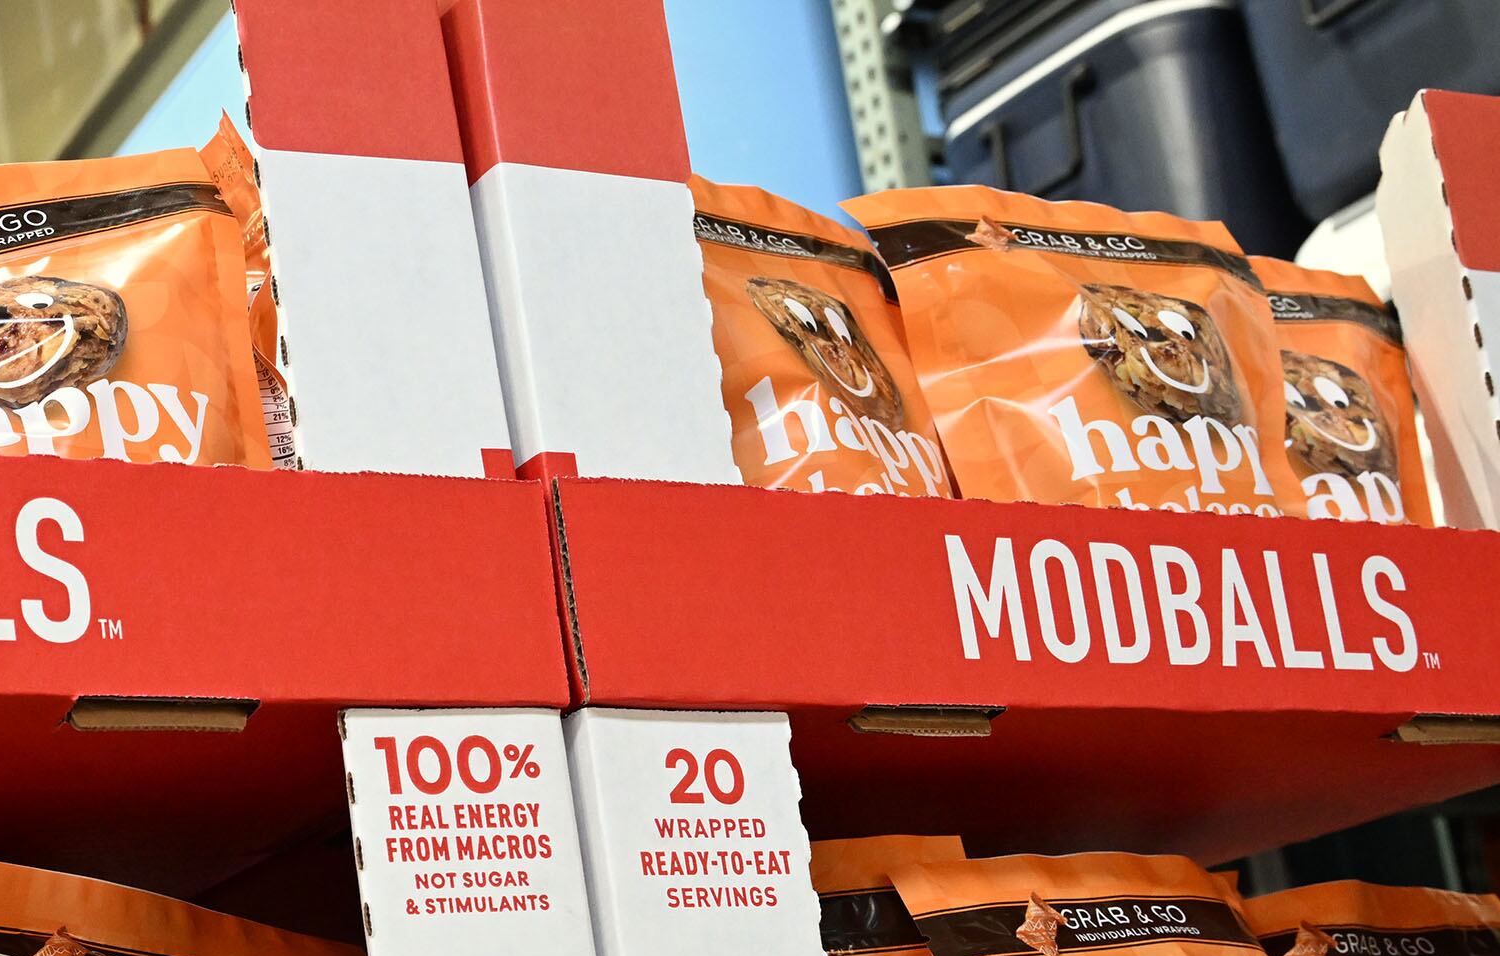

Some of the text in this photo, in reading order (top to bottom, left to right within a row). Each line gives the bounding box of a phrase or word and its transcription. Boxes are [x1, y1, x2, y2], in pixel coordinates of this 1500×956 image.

[766, 234, 803, 249] GO
[1011, 228, 1082, 250] GRAB
[1085, 236, 1107, 250] &
[1106, 236, 1146, 251] GO
[1267, 295, 1301, 312] GO
[944, 534, 1419, 673] MODBALLS
[373, 734, 542, 796] 100%
[665, 747, 746, 806] 20
[388, 802, 542, 832] REAL ENERGY
[653, 817, 767, 840] WRAPPED
[385, 833, 553, 863] FROM MACROS
[639, 849, 793, 877] READY-TO-EAT
[414, 870, 531, 890] NOT SUGAR
[404, 893, 552, 915] & STIMULANTS
[666, 885, 778, 909] SERVINGS
[1060, 904, 1188, 930] GRAB & GO
[1075, 926, 1201, 943] INDIVIDUALLY WRAPPED
[1331, 932, 1436, 956] GRAB & GO
